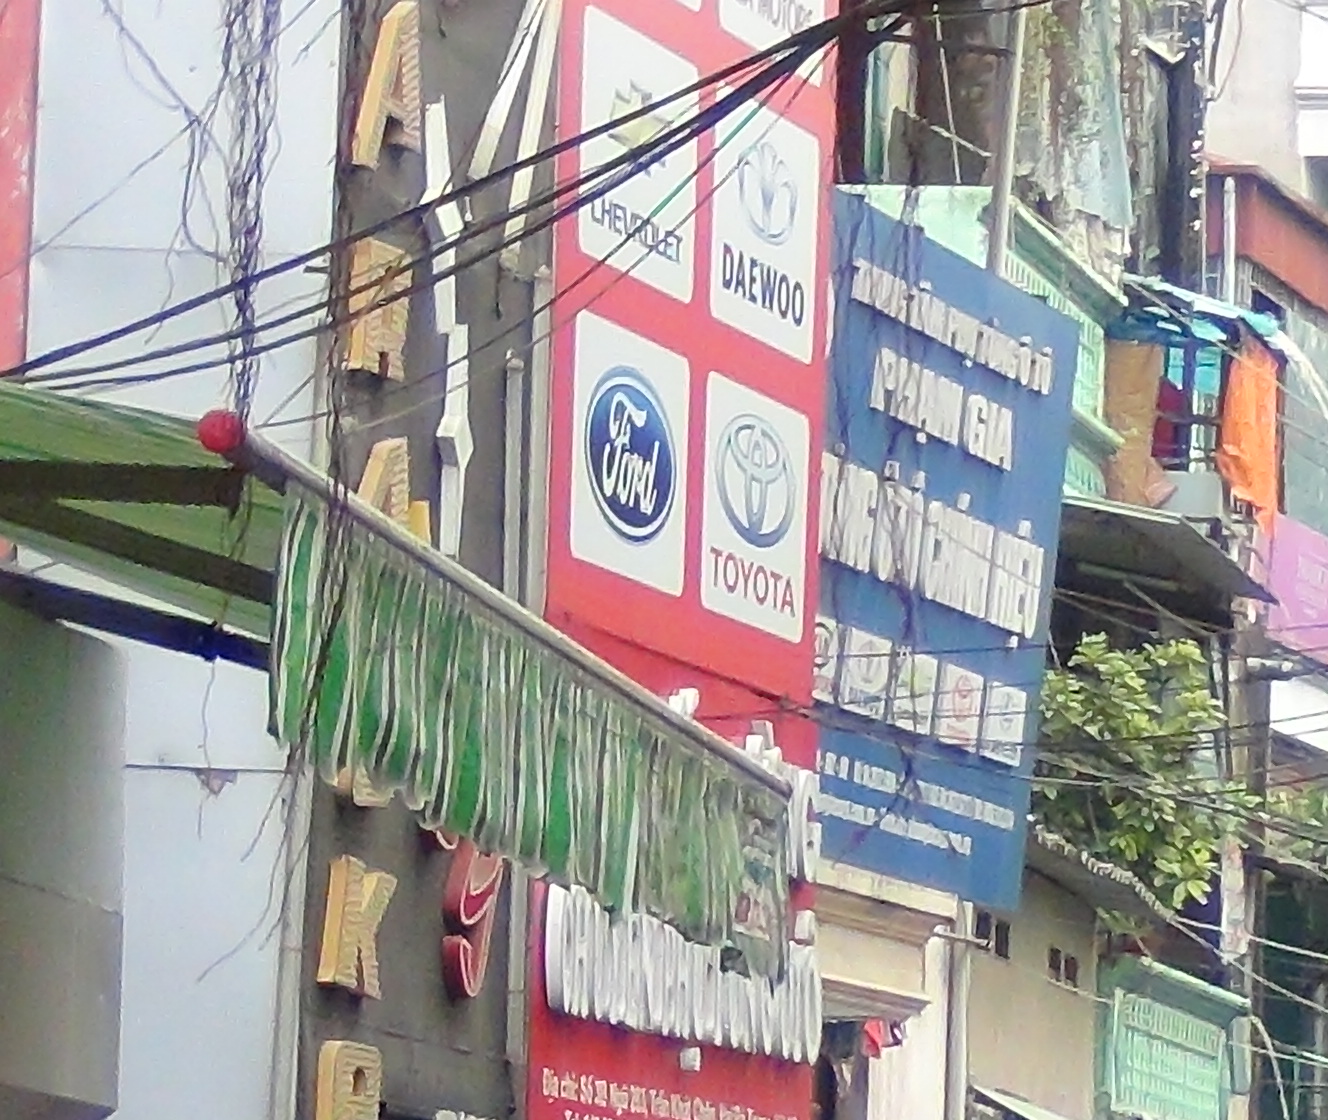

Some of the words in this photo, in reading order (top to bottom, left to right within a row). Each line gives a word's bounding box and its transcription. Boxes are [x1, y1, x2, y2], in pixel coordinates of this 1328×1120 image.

[590, 198, 682, 264] CHEVROLET
[722, 241, 805, 327] DAEWOO
[869, 346, 964, 446] PHẠM
[962, 393, 1014, 472] GIA
[602, 391, 661, 516] Ford
[710, 546, 797, 618] TOYOTA
